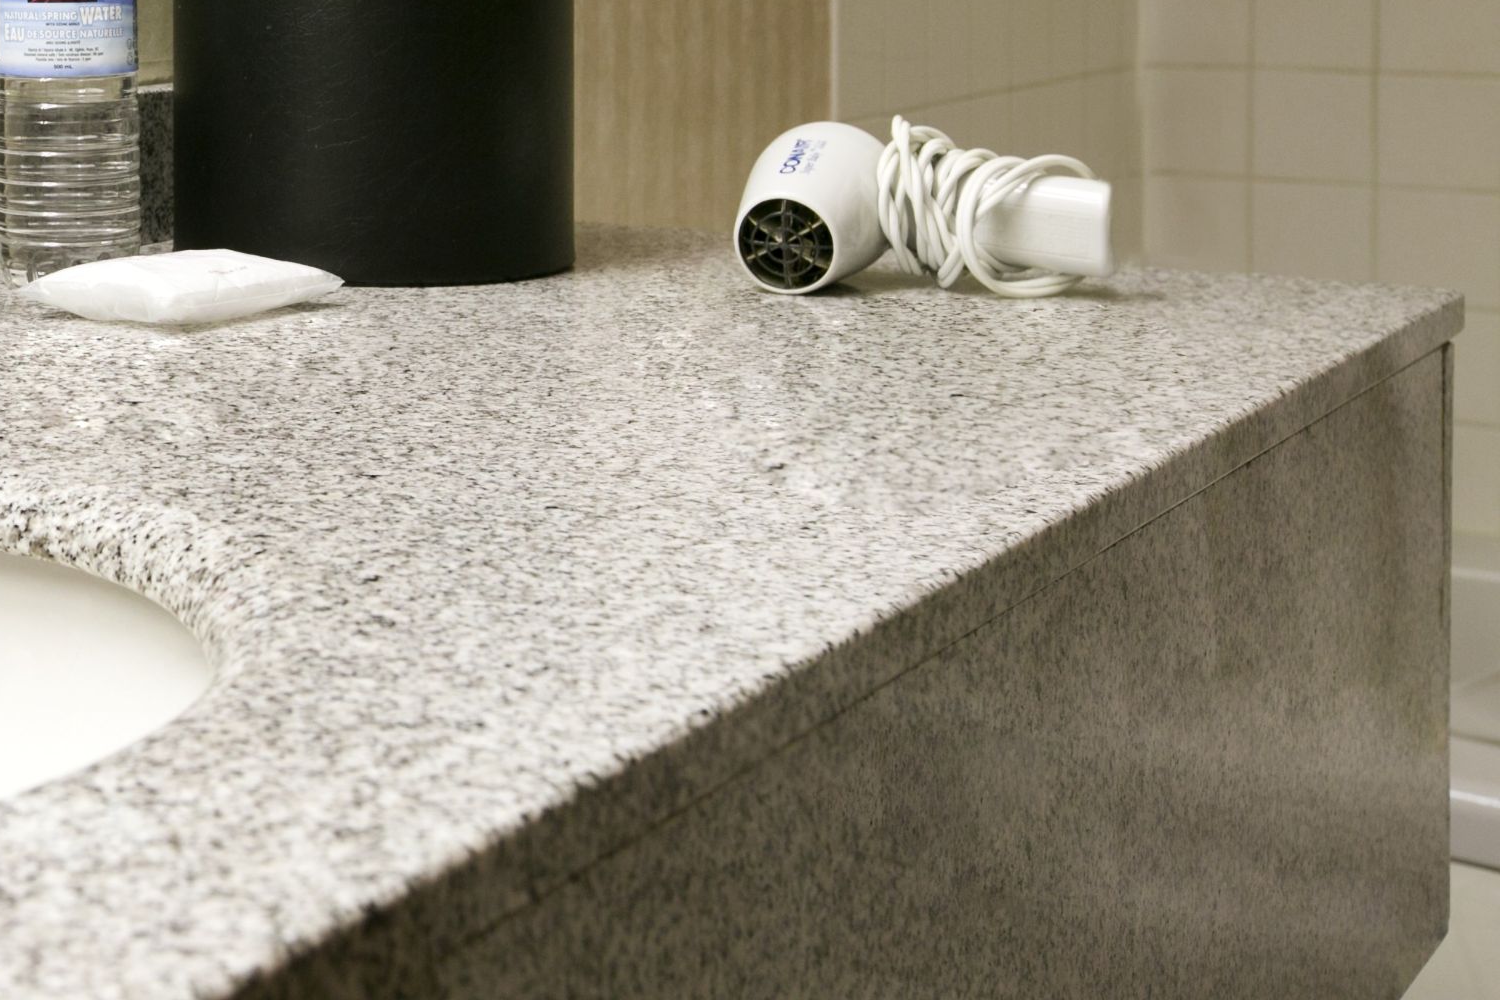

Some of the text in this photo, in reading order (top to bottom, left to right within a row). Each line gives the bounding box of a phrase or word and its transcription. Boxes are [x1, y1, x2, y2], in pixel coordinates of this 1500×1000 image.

[4, 5, 122, 25] NATURAL SPRING WATER
[4, 23, 124, 42] EAU DE SOURCE NATURELLE
